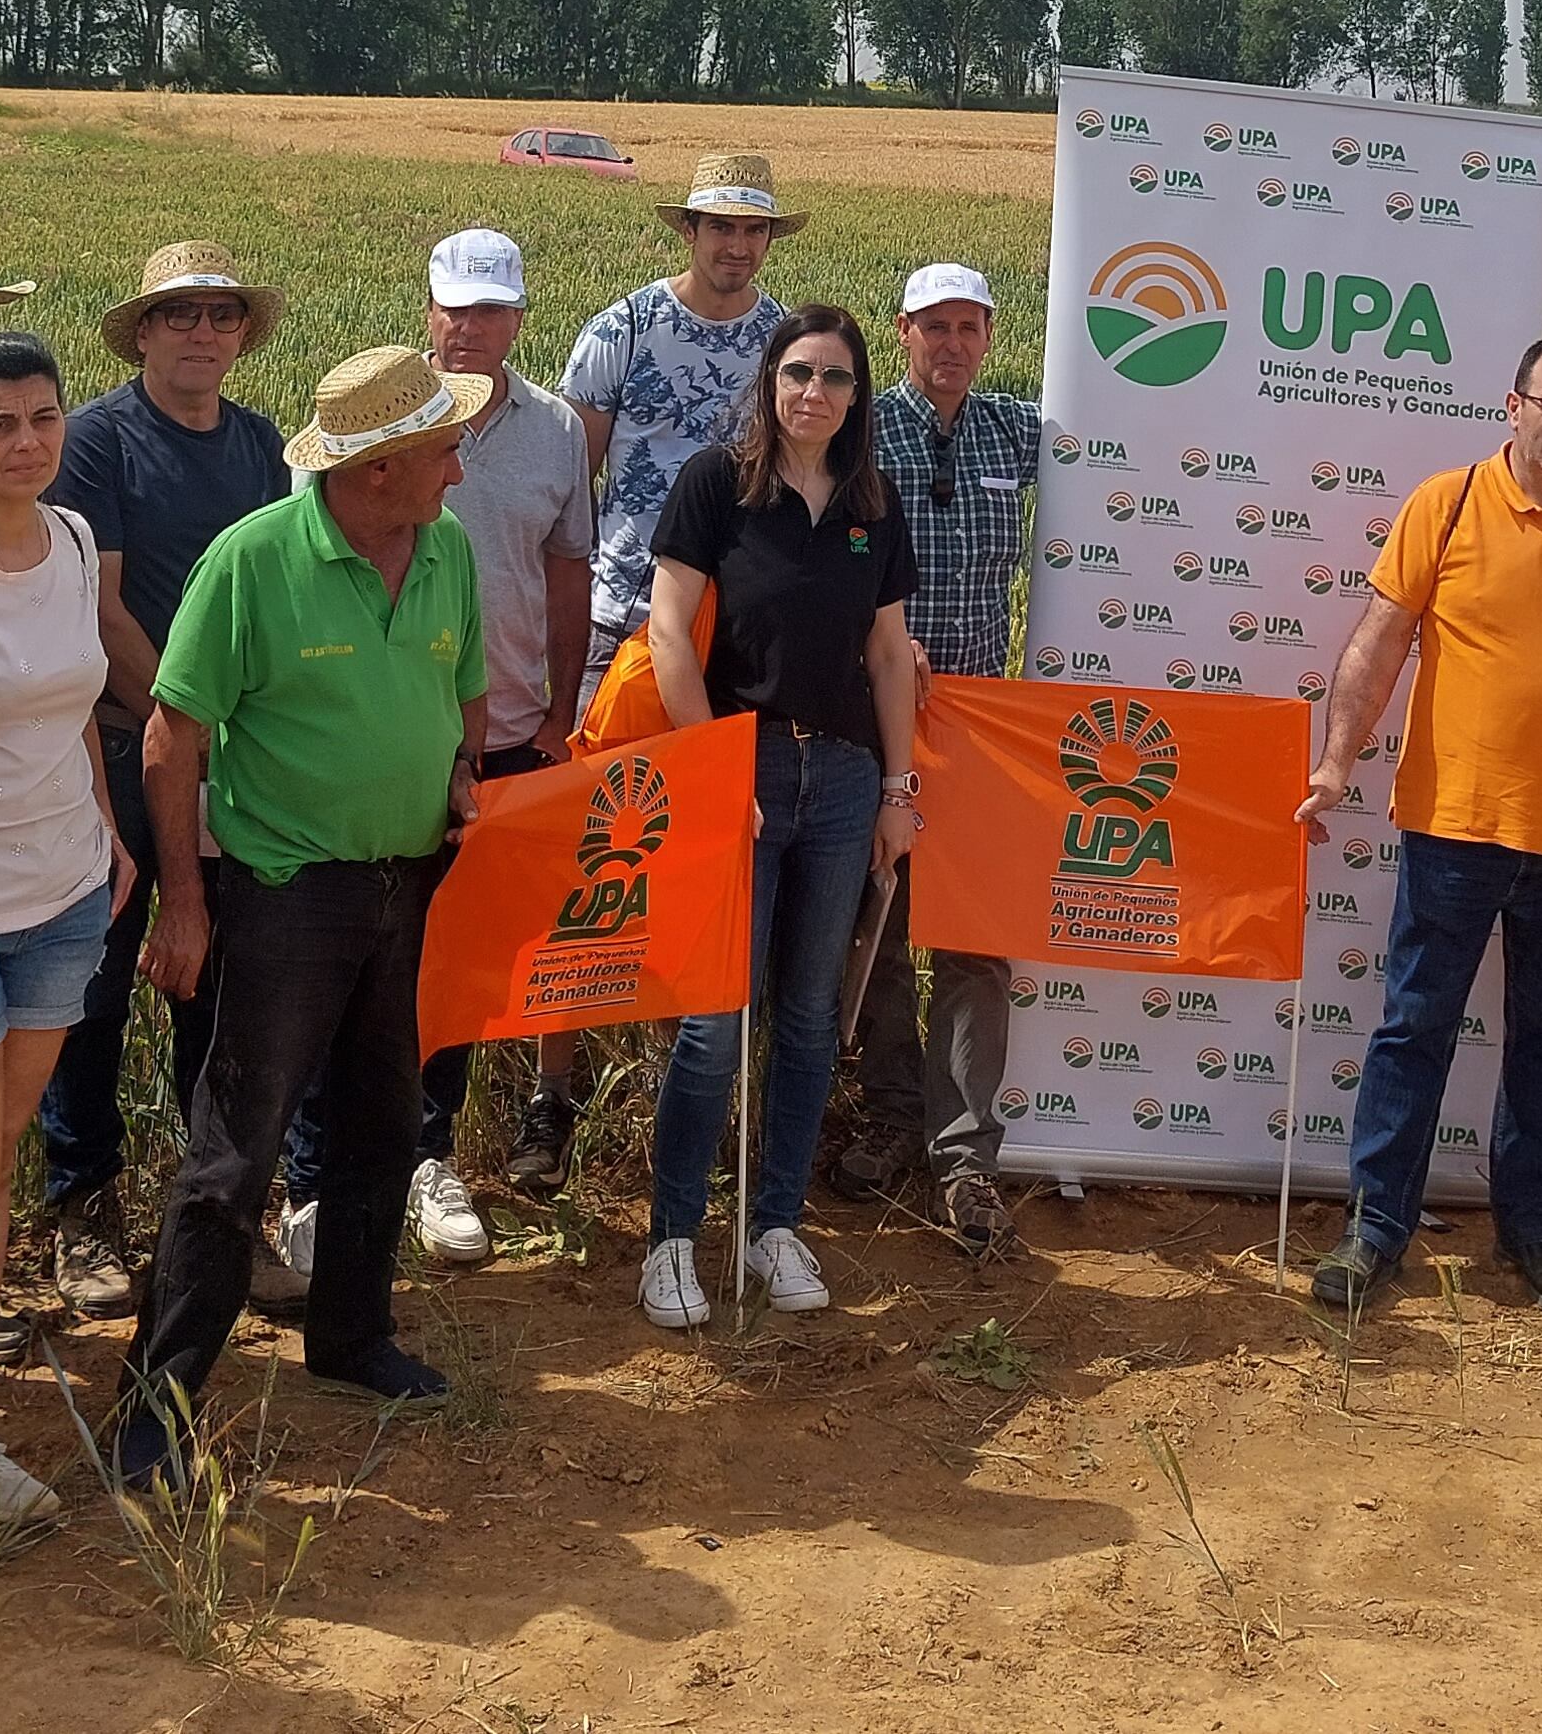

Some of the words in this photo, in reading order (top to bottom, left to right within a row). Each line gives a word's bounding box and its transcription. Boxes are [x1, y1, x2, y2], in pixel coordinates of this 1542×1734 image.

[1111, 115, 1149, 134] UPA
[1239, 128, 1277, 148] UPA
[1367, 142, 1405, 161] UPA
[1497, 156, 1536, 176] UPA
[1164, 170, 1203, 189] UPA
[1293, 183, 1331, 203] UPA
[1421, 197, 1460, 216] UPA
[1262, 267, 1452, 364] UPA
[1259, 359, 1316, 381] Unión
[1322, 367, 1348, 384] de
[1355, 369, 1453, 396] Pequeños
[1258, 381, 1381, 409] Agricultores
[1387, 397, 1398, 414] y
[1403, 396, 1508, 422] Ganadero
[1088, 440, 1127, 460] UPA
[1217, 454, 1256, 473] UPA
[1347, 466, 1385, 486] UPA
[1142, 496, 1180, 516] UPA
[1272, 511, 1311, 530] UPA
[1080, 544, 1119, 564] UPA
[1209, 558, 1250, 578] UPA
[1133, 605, 1172, 624] UPA
[1265, 616, 1304, 636] UPA
[1072, 652, 1111, 672] UPA
[1202, 665, 1242, 685] UPA
[1341, 786, 1363, 804] PA
[1058, 812, 1176, 877] UPA
[1052, 884, 1089, 899] Unión
[1093, 890, 1109, 901] de
[1114, 892, 1177, 906] Pequeños
[1317, 892, 1357, 913] UPA
[546, 872, 648, 943] UPA
[1051, 901, 1178, 926] Agricultores
[1050, 923, 1062, 938] y
[1068, 922, 1178, 945] Ganaderos
[569, 953, 585, 964] de
[528, 962, 642, 987] Agricultores
[524, 994, 535, 1010] y
[541, 979, 637, 1004] Ganaderos
[1044, 981, 1085, 1002] UPA
[1178, 992, 1218, 1012] UPA
[1312, 1004, 1352, 1024] UPA
[1460, 1017, 1485, 1034] PA
[1100, 1042, 1140, 1062] UPA
[1234, 1054, 1275, 1074] UPA
[1036, 1093, 1076, 1113] UPA
[1170, 1104, 1211, 1124] UPA
[1305, 1115, 1344, 1135] UPA
[1438, 1126, 1479, 1146] UPA
